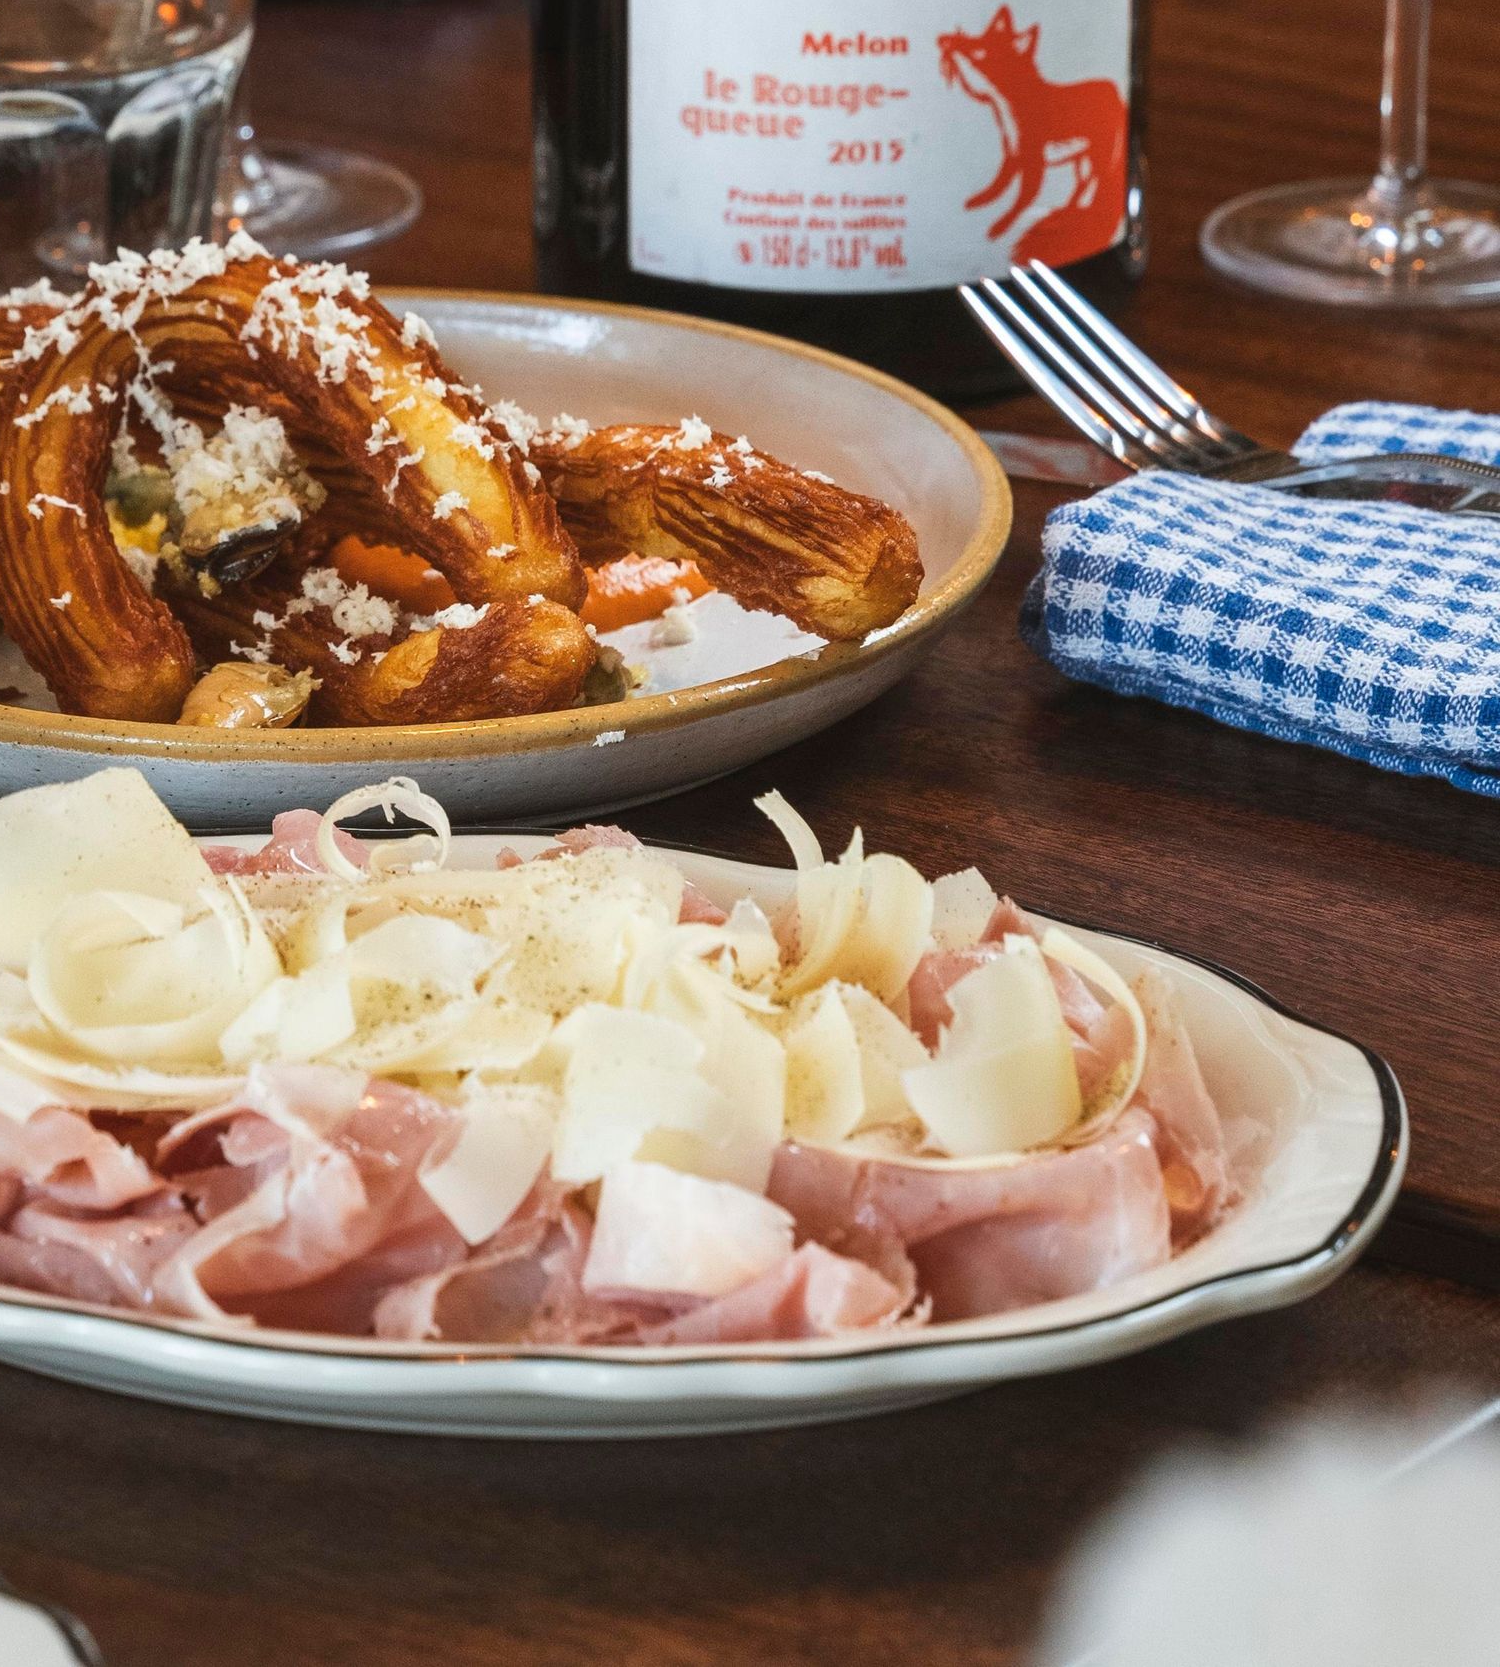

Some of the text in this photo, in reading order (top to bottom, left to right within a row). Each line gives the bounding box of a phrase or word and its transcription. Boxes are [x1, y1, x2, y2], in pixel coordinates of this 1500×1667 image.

[801, 31, 910, 55] Melon
[703, 69, 910, 116] le Rouge-
[680, 105, 805, 138] queue
[829, 138, 905, 164] 2015
[810, 193, 834, 207] de
[840, 193, 907, 208] France
